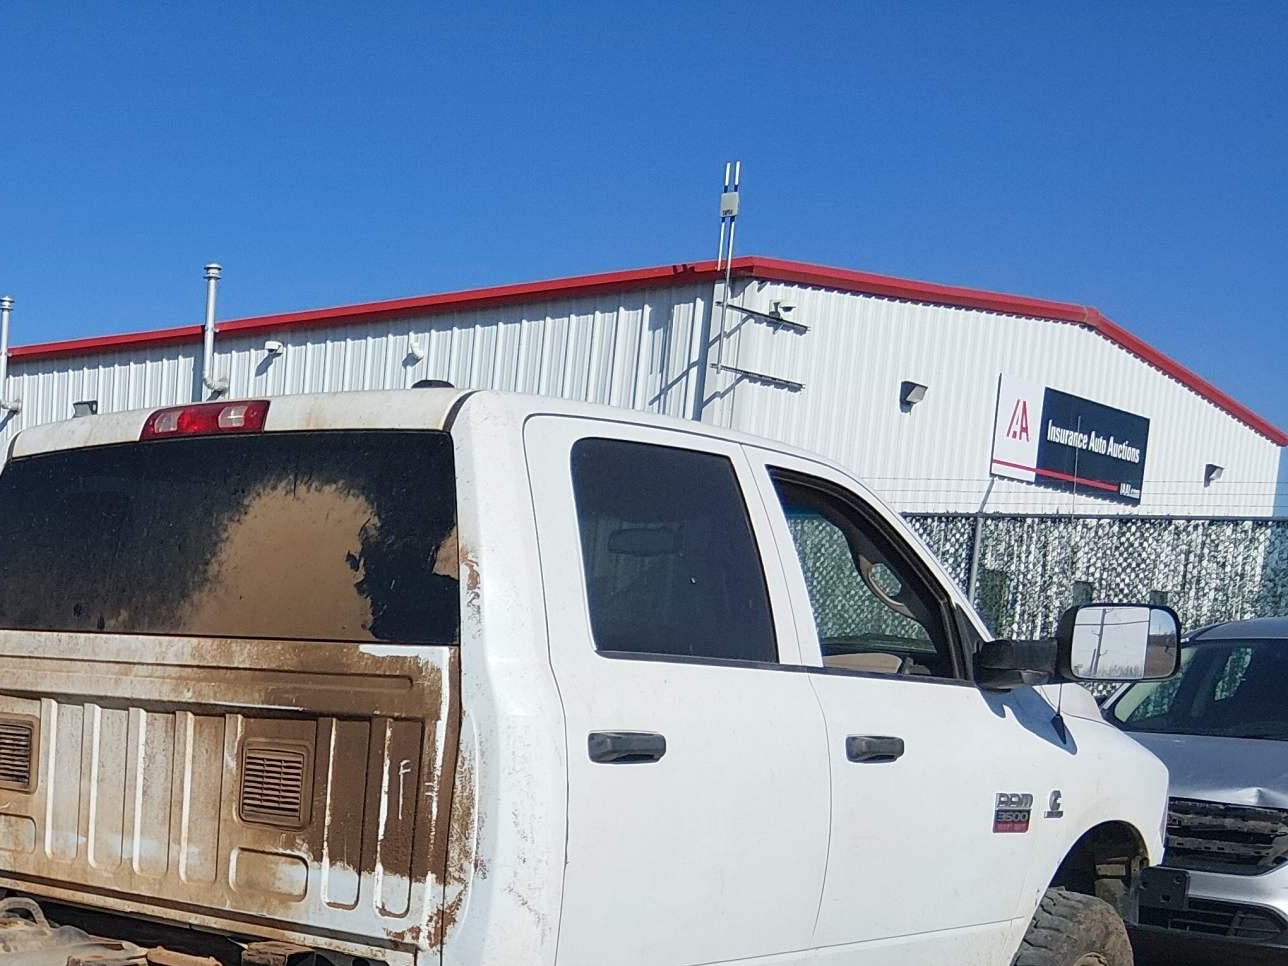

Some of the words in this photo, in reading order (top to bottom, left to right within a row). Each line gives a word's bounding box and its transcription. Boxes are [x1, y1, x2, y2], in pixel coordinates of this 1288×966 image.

[1047, 419, 1088, 450] Insurance
[1089, 430, 1107, 455] Auto
[1107, 435, 1141, 464] Auctions
